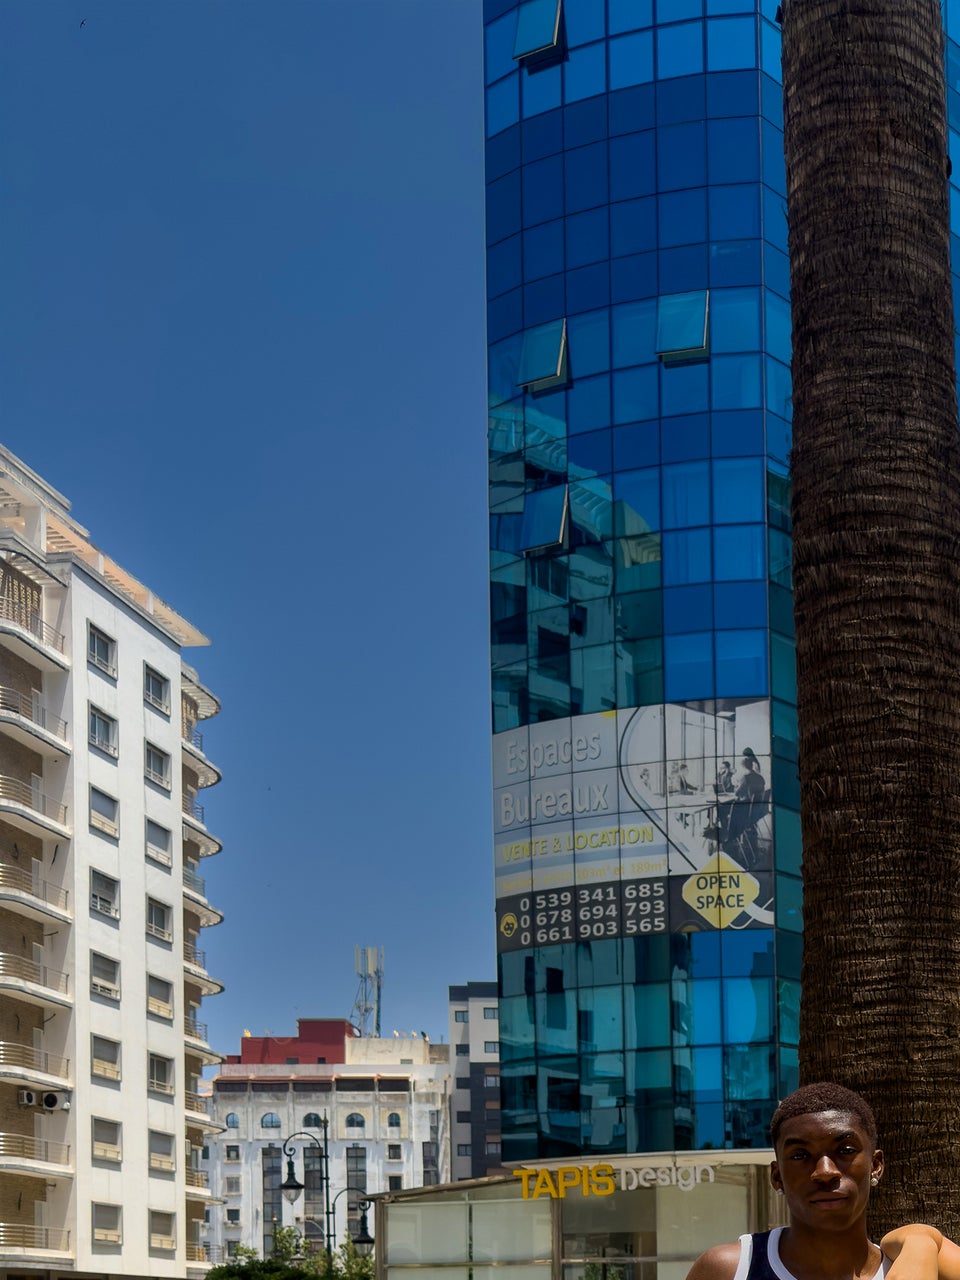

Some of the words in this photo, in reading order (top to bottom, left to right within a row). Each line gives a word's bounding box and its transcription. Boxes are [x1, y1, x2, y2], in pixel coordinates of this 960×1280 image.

[505, 732, 602, 778] Espaces
[500, 783, 609, 827] Bureaux
[502, 840, 548, 862] VENTE
[552, 837, 561, 853] &
[565, 826, 654, 851] LOCATION
[536, 892, 572, 909] 539
[578, 887, 617, 904] 341
[624, 882, 665, 899] 685
[696, 875, 740, 890] OPEN
[536, 909, 572, 926] 678
[579, 904, 618, 921] 694
[625, 900, 666, 917] 793
[696, 894, 745, 910] SPACE
[536, 926, 573, 943] 661
[579, 921, 618, 938] 903
[626, 917, 666, 934] 565
[512, 1164, 616, 1200] TAPIS
[620, 1164, 715, 1191] Design
